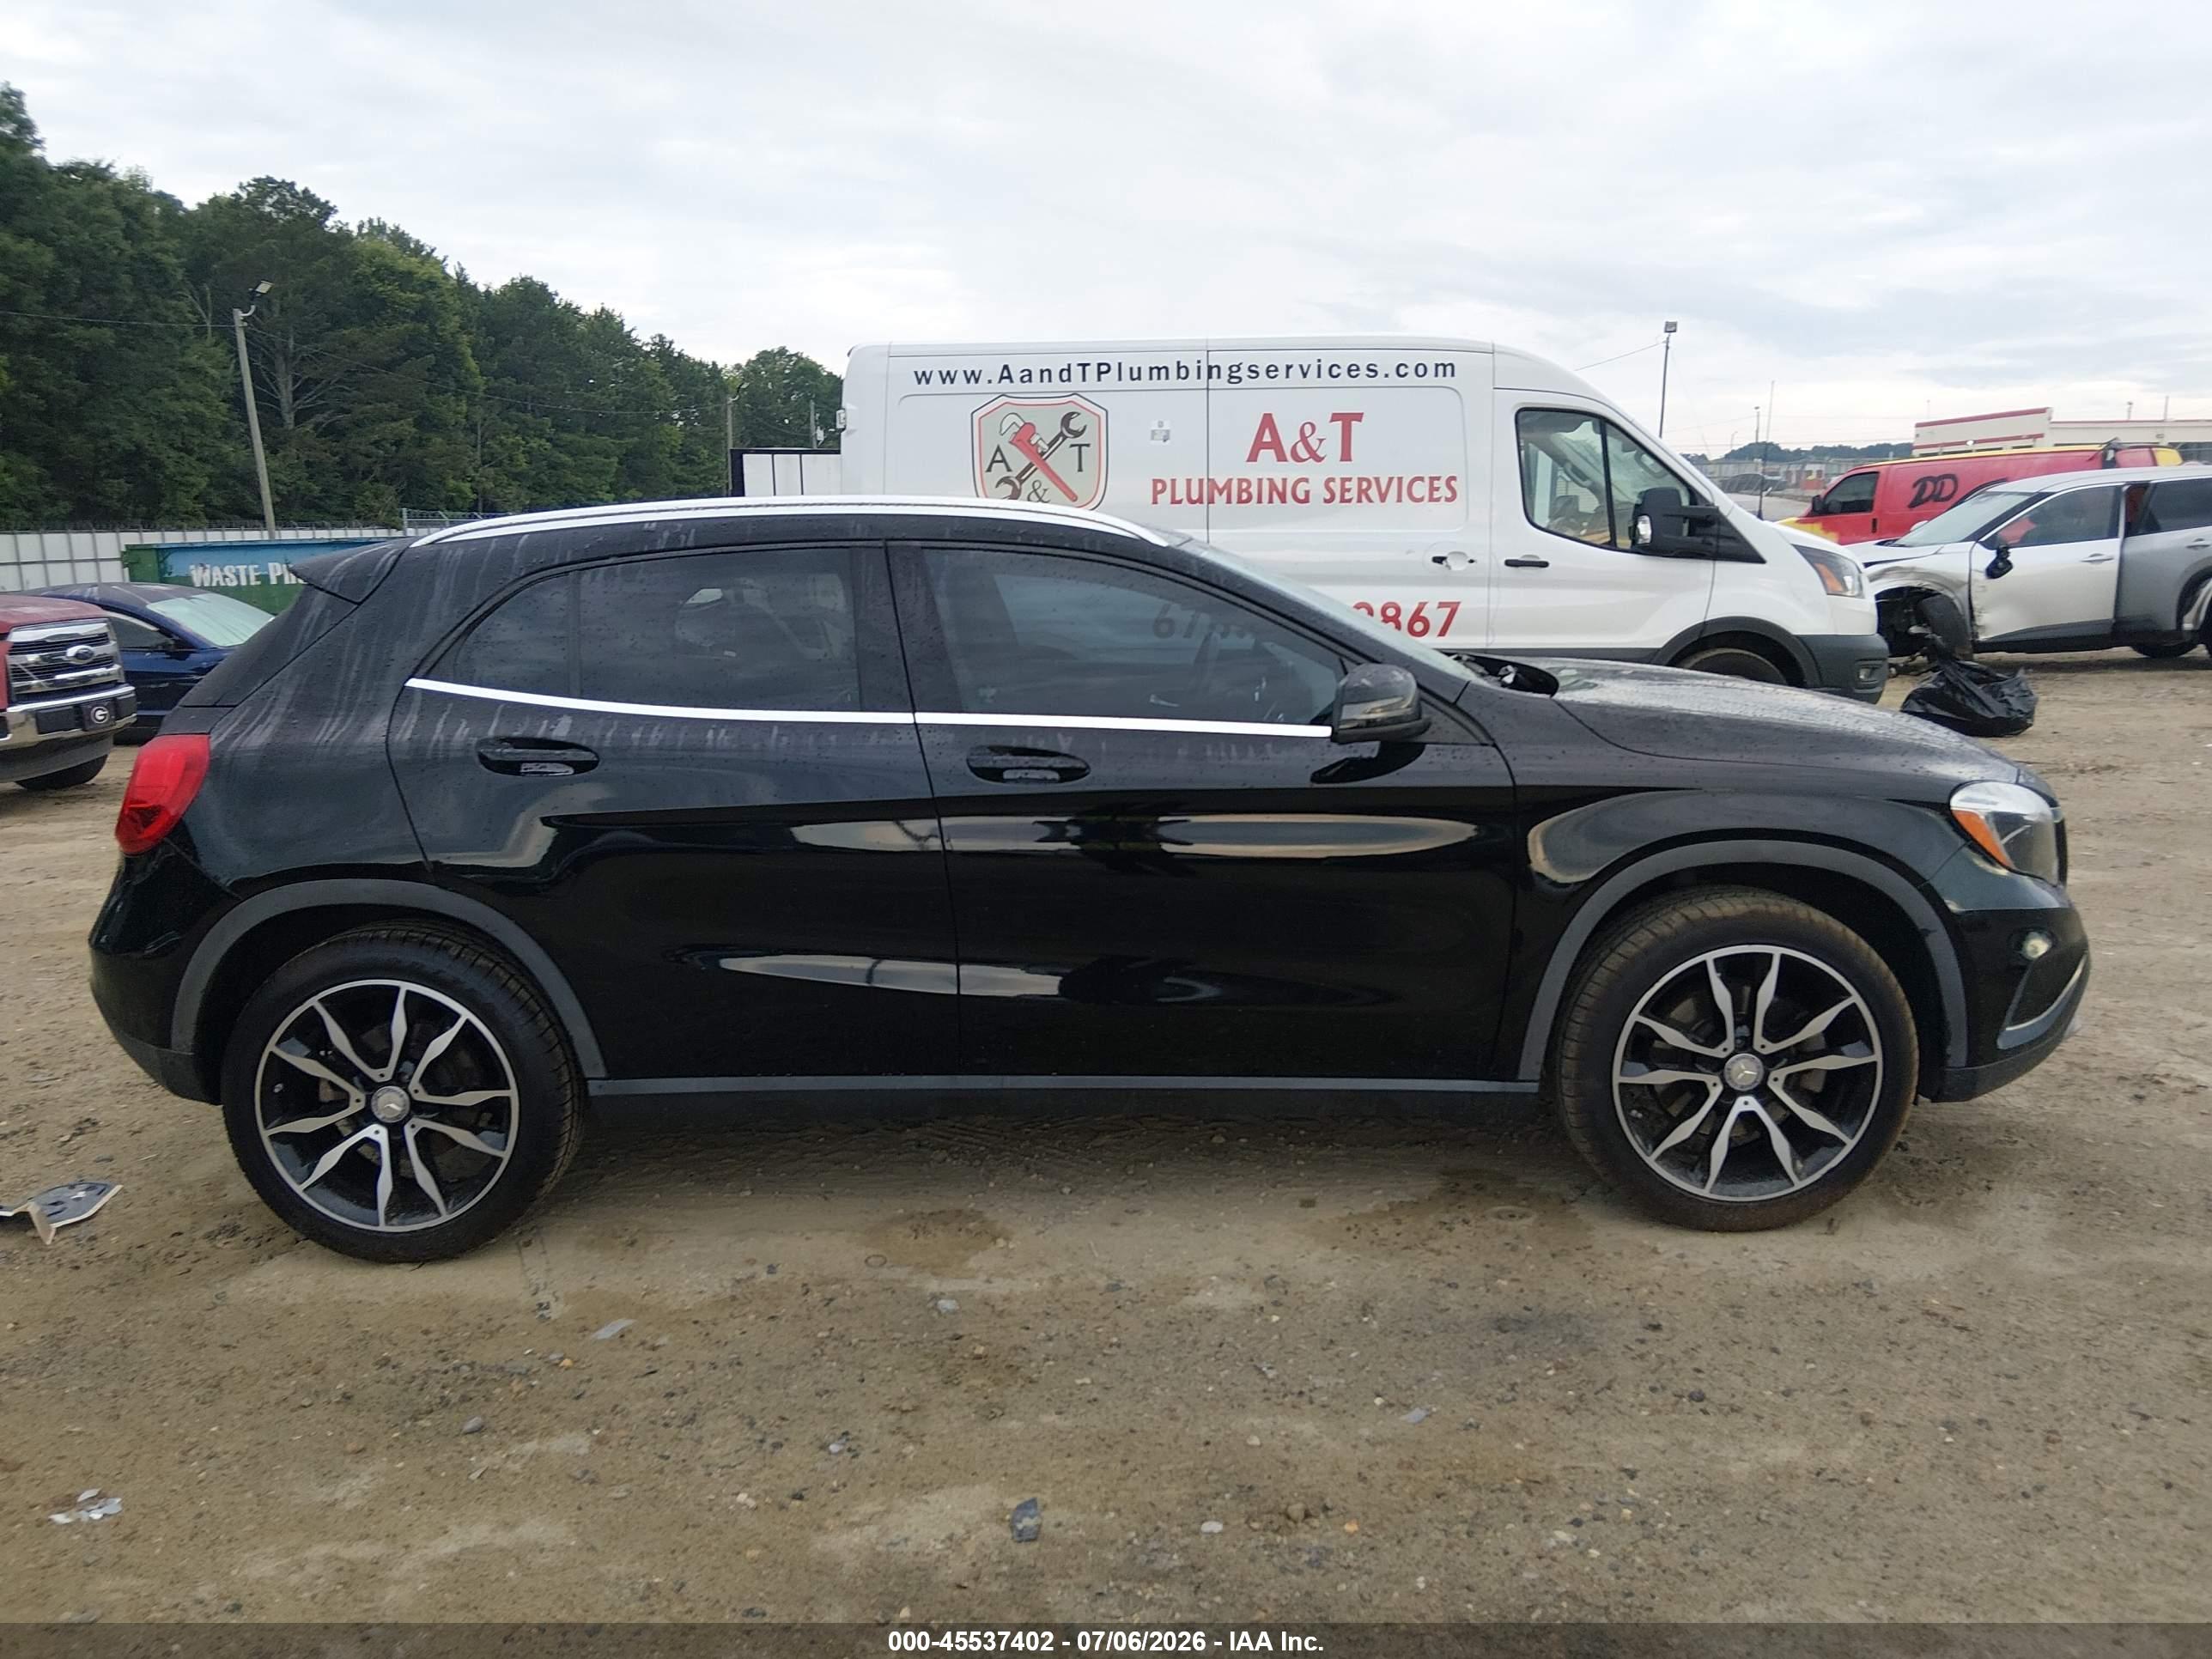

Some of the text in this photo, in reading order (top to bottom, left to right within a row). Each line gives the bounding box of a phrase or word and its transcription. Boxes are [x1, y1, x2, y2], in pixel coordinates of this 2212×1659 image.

[914, 358, 1456, 386] www.AandTPlumbingservices.com
[1247, 411, 1364, 463] A&T
[985, 443, 1091, 473] A T
[1152, 477, 1458, 506] PLUMBING SERVICES
[189, 563, 261, 586] WASTE
